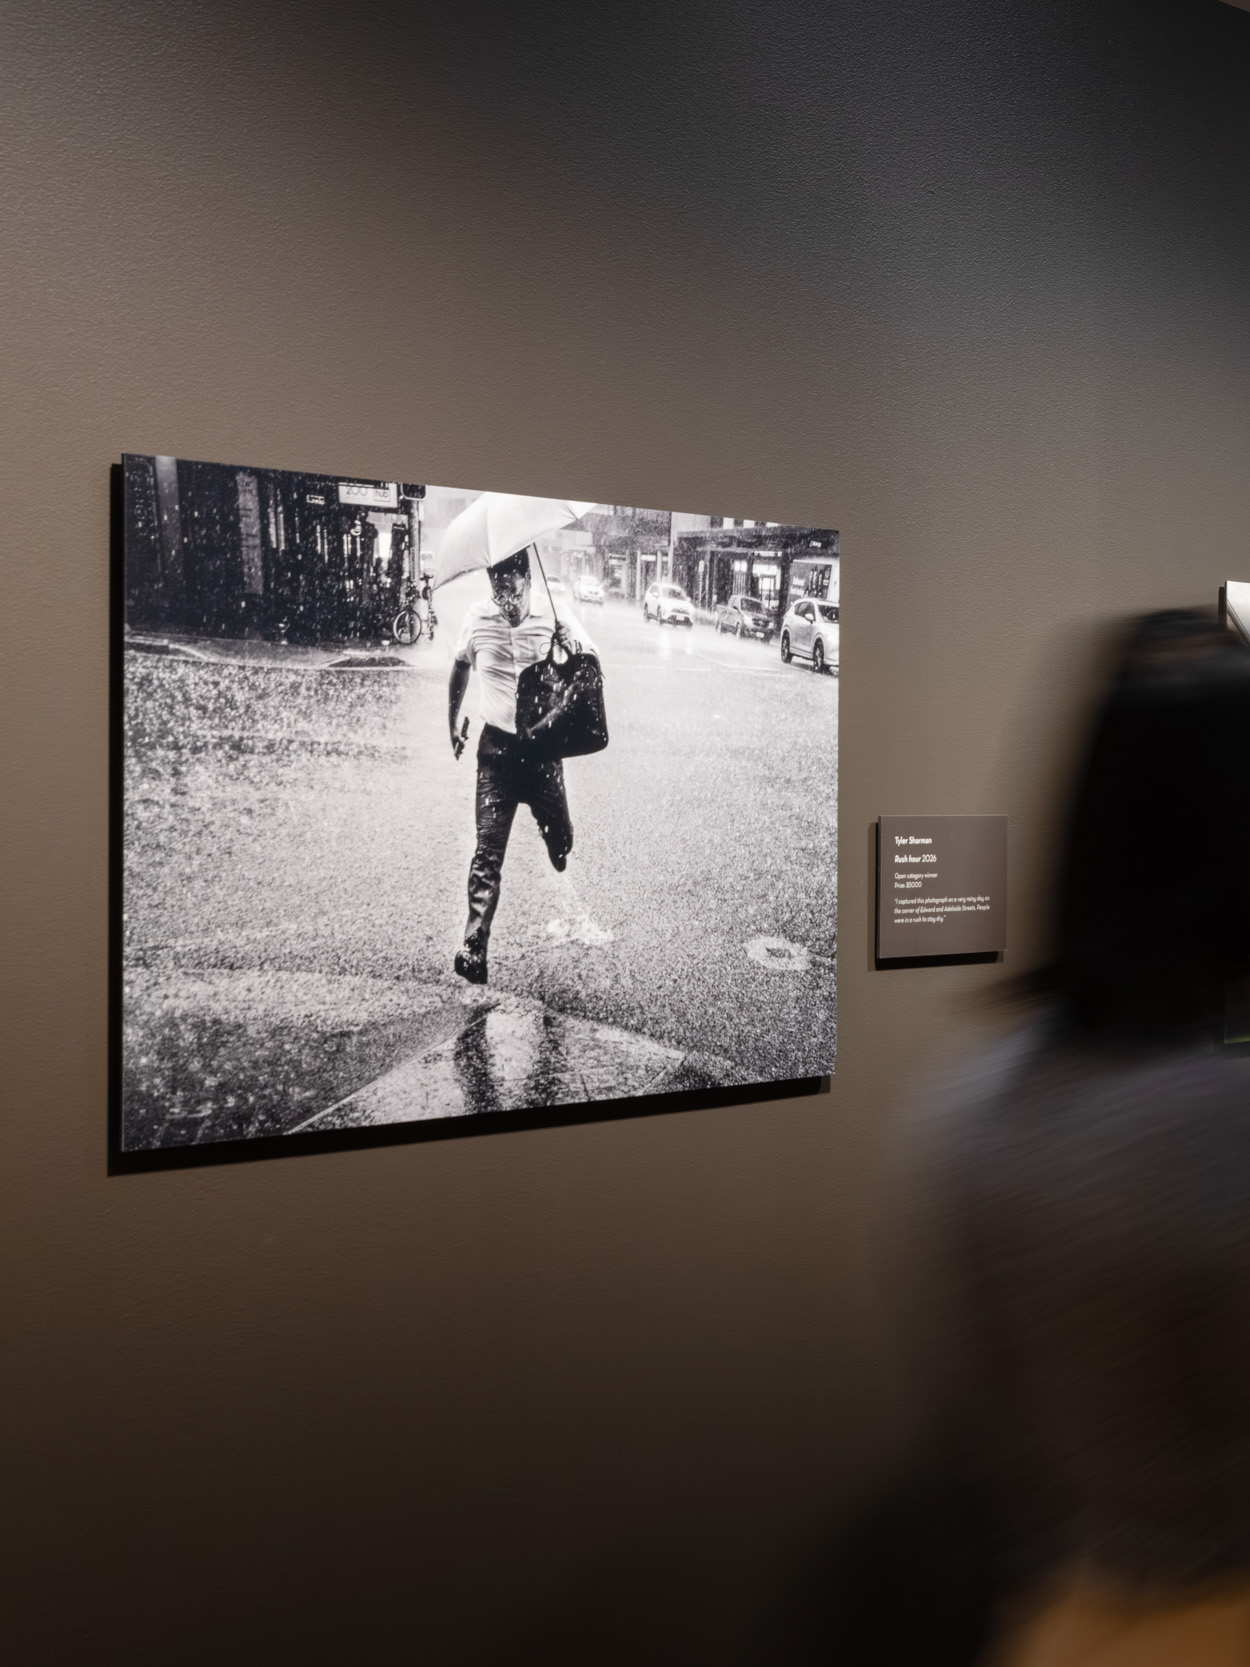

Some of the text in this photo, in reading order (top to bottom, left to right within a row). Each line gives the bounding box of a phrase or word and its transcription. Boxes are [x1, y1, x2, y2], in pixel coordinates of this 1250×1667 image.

[894, 836, 932, 846] Tyler Sharman
[895, 854, 937, 863] Rush hour 2026
[899, 897, 916, 905] captured
[925, 896, 947, 905] photograph
[915, 906, 920, 914] of
